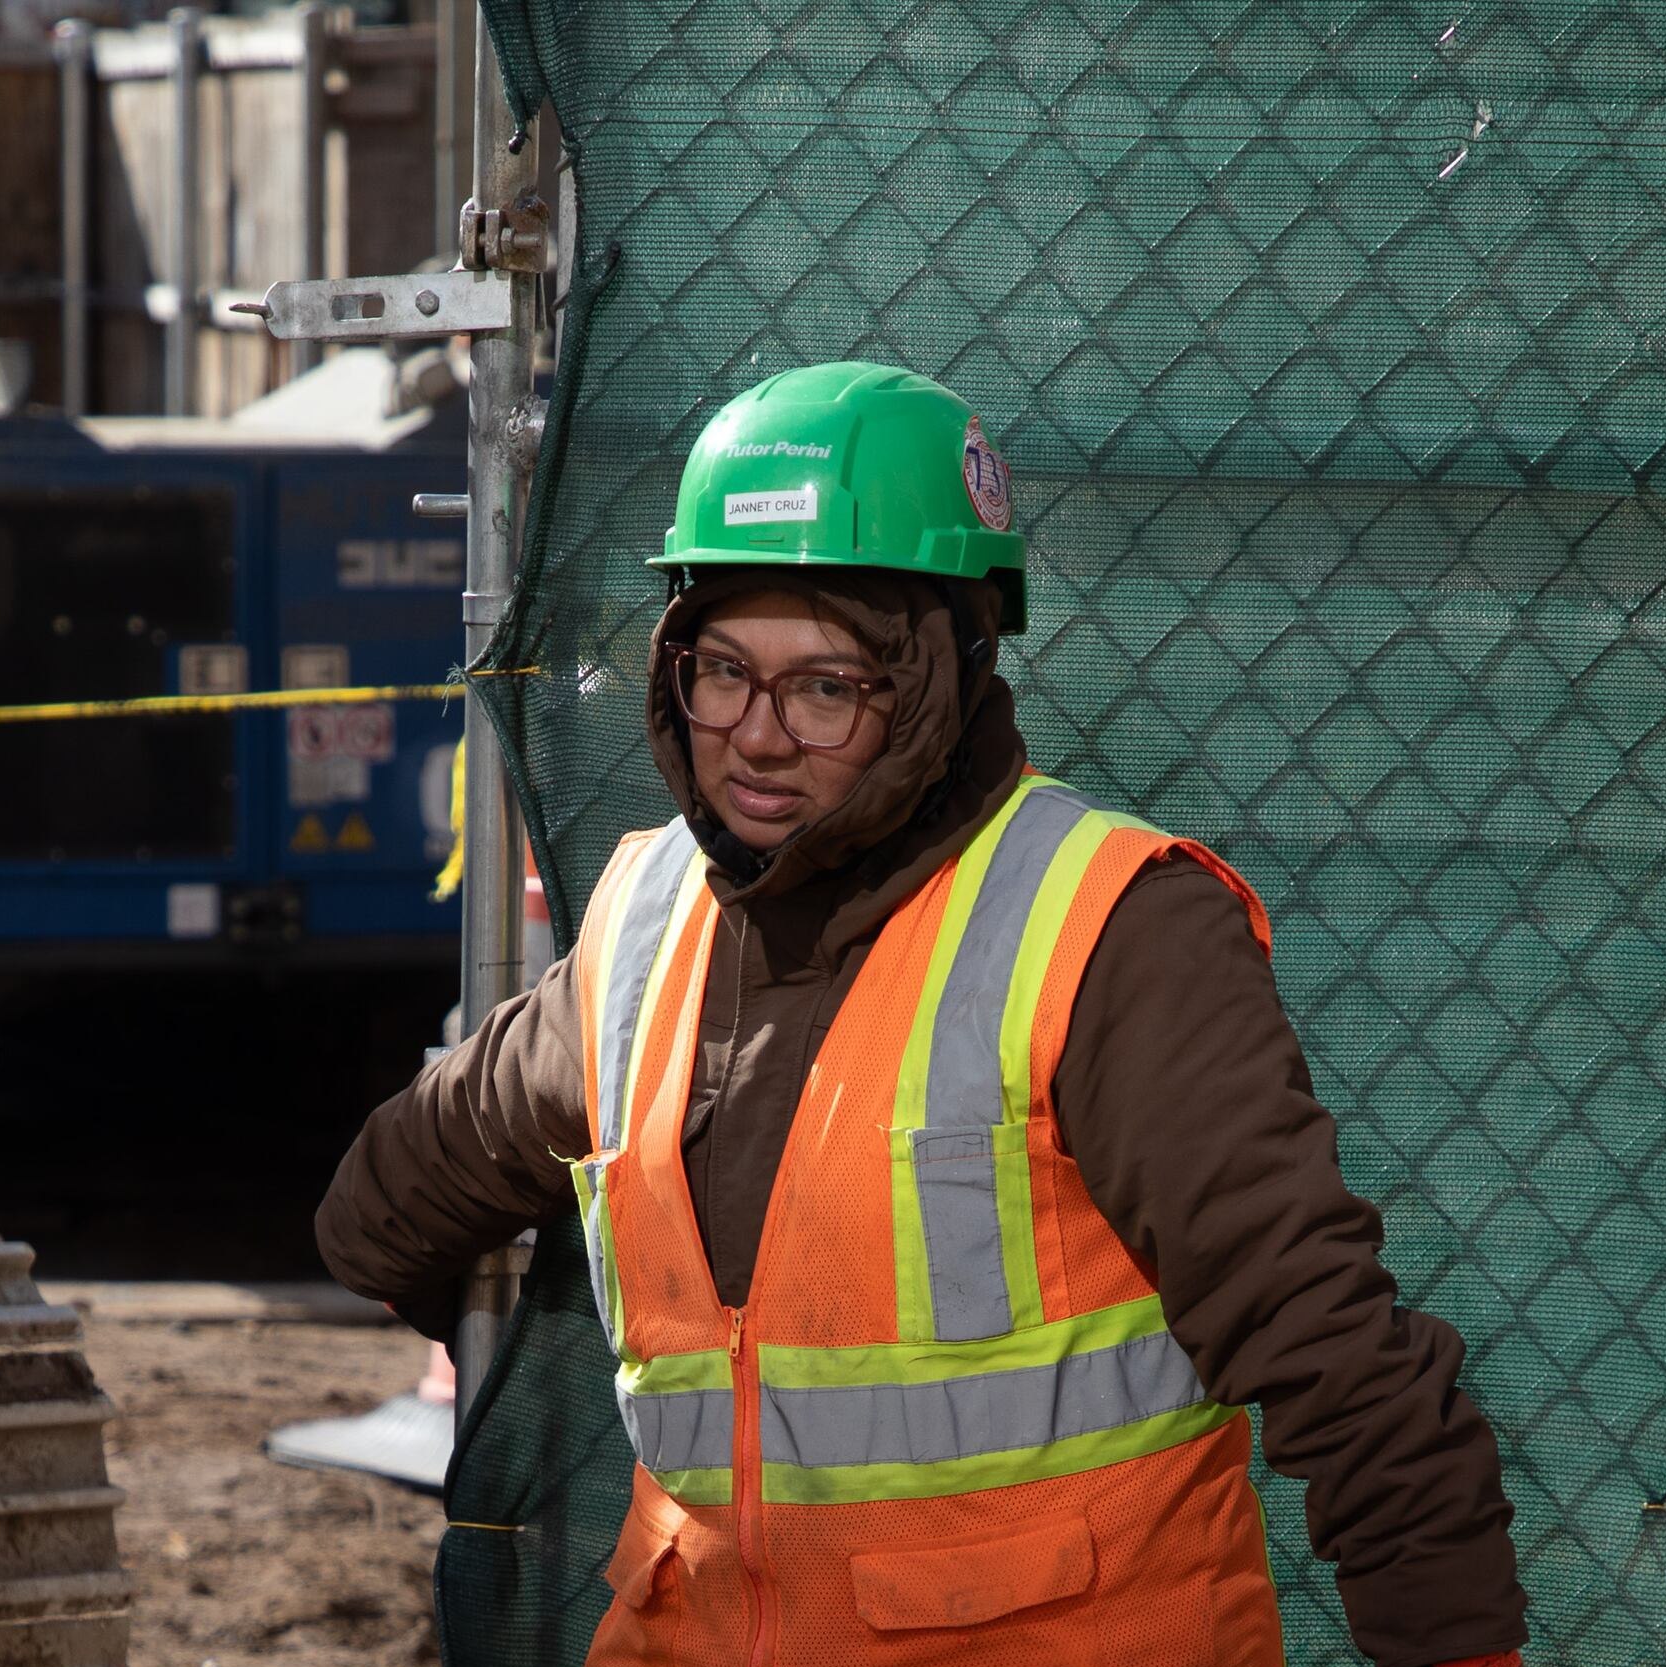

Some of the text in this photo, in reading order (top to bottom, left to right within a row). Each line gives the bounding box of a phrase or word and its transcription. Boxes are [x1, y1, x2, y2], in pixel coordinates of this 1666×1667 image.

[726, 441, 831, 458] Tutor Perini
[966, 447, 1010, 502] 731
[729, 500, 807, 515] JANNET CRUZ
